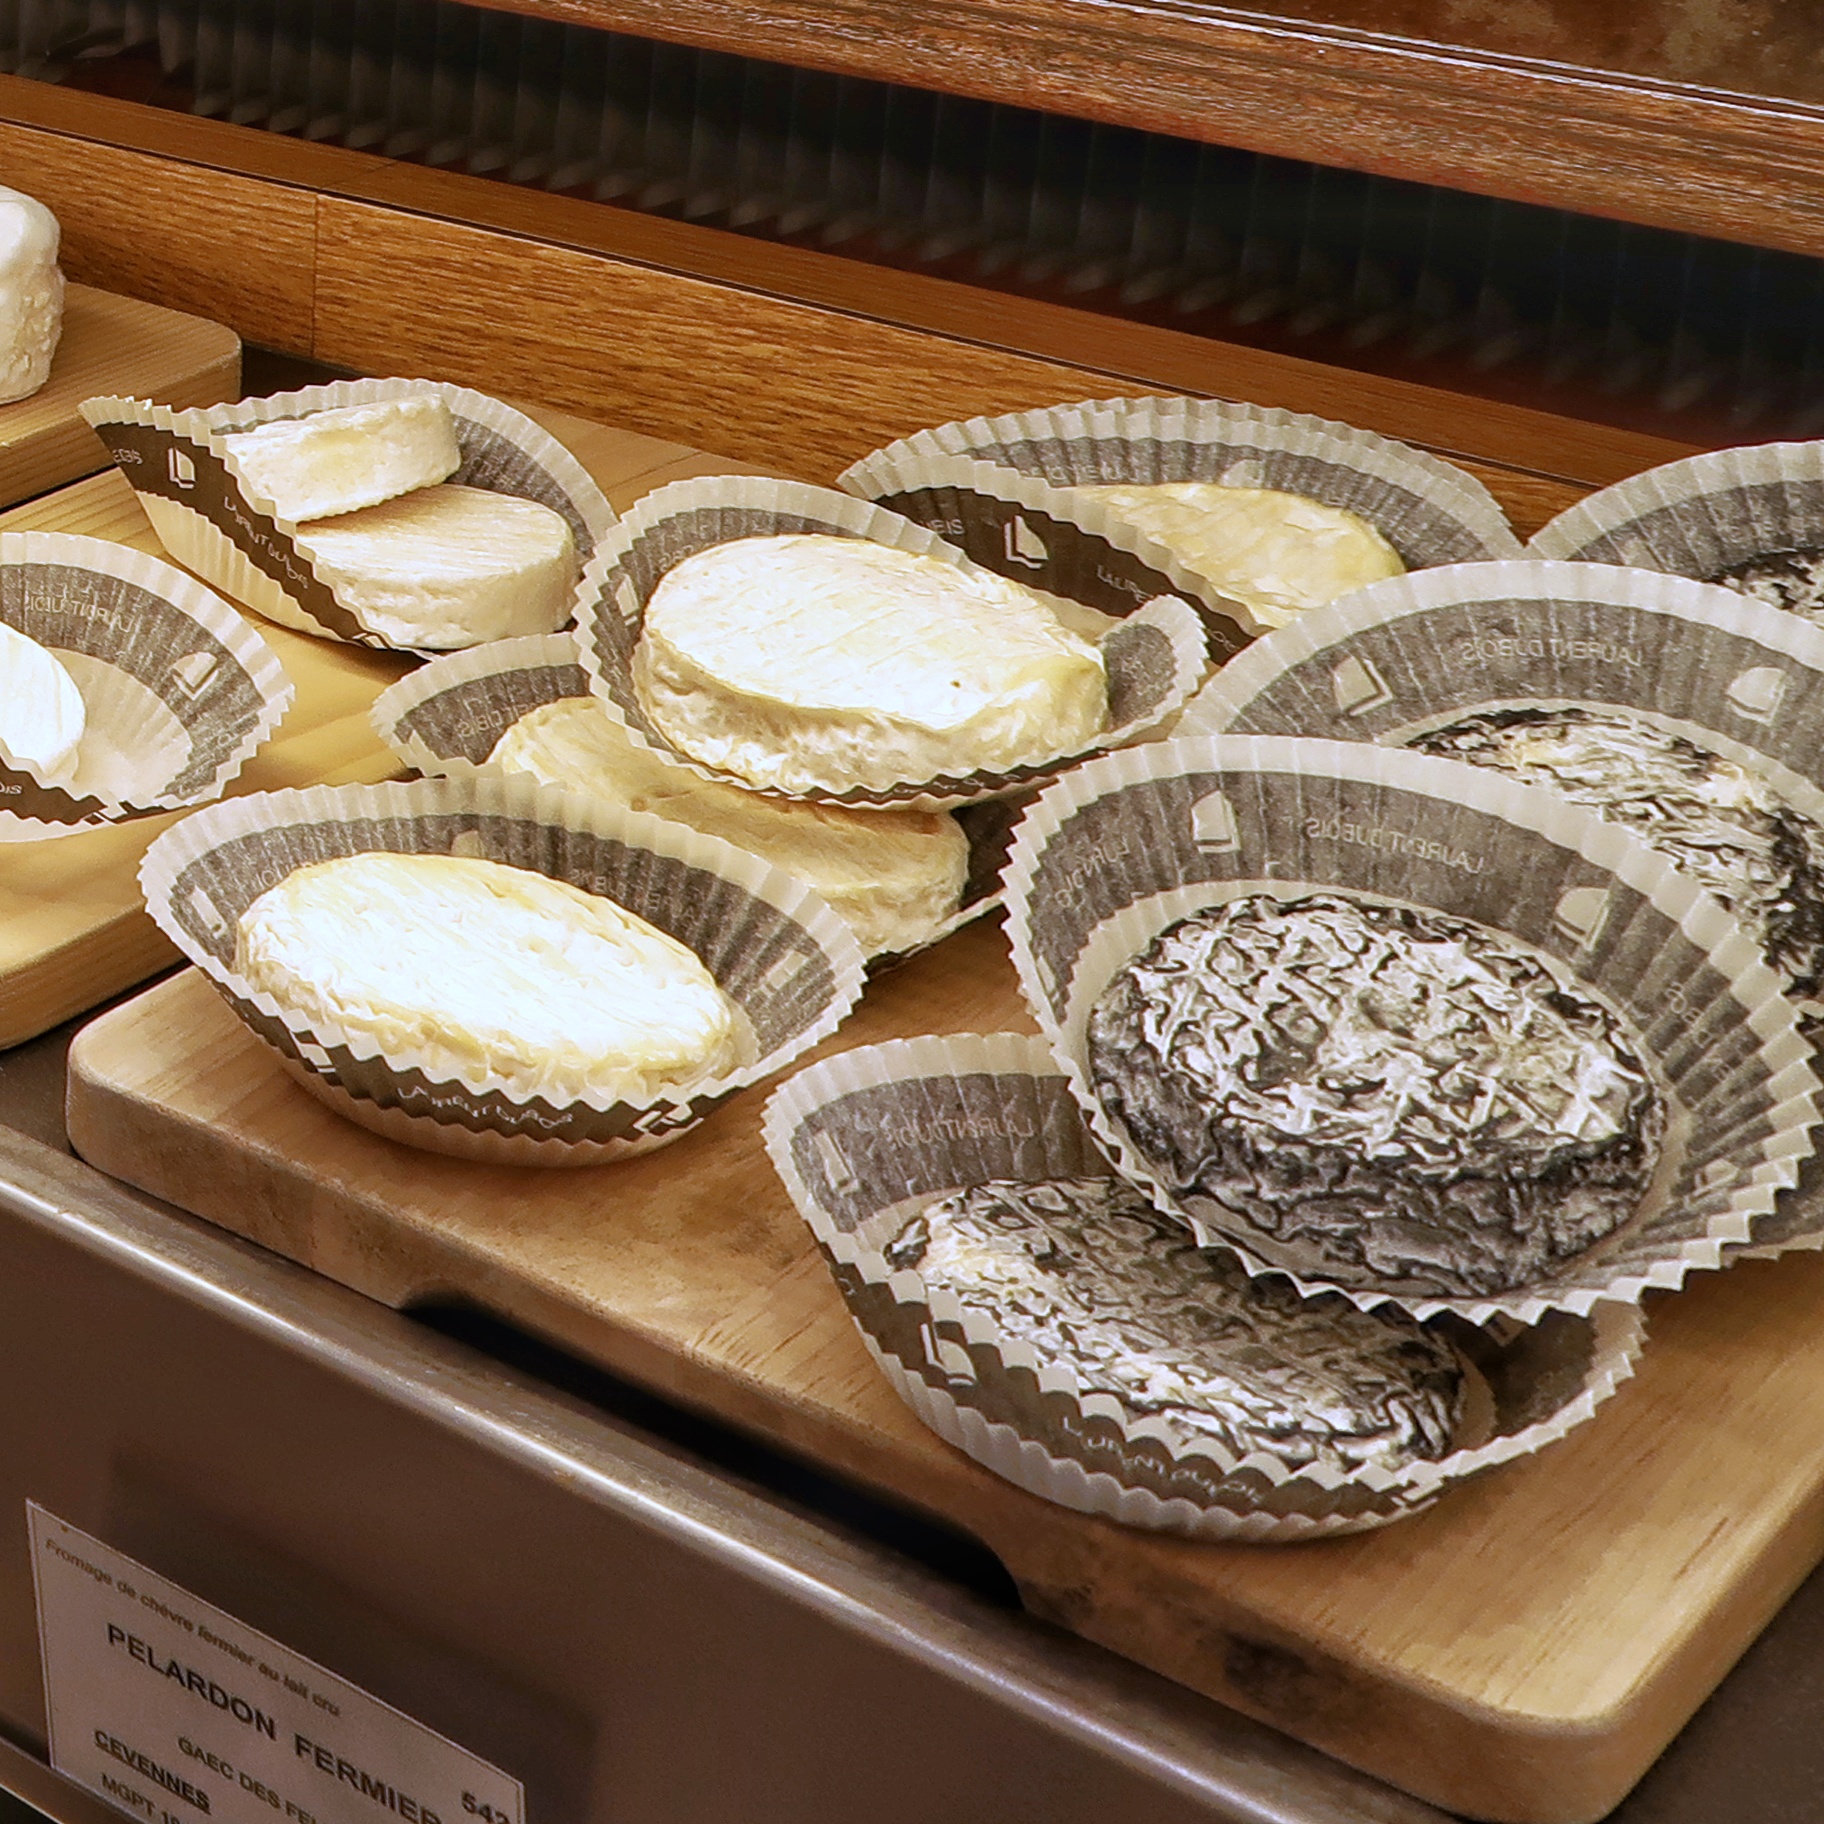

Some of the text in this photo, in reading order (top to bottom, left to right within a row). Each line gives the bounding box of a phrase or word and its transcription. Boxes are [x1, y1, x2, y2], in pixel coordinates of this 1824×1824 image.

[45, 1537, 114, 1588] Fromage
[117, 1578, 137, 1600] de
[197, 1624, 256, 1667] fermier
[258, 1660, 281, 1684] au
[283, 1672, 309, 1701] lait
[312, 1689, 342, 1719] cru
[106, 1621, 442, 1824] PELARDON FERMIER
[93, 1728, 212, 1816] CEVENNES
[101, 1773, 157, 1817] MGPT
[177, 1734, 319, 1824] GAEC DES FE
